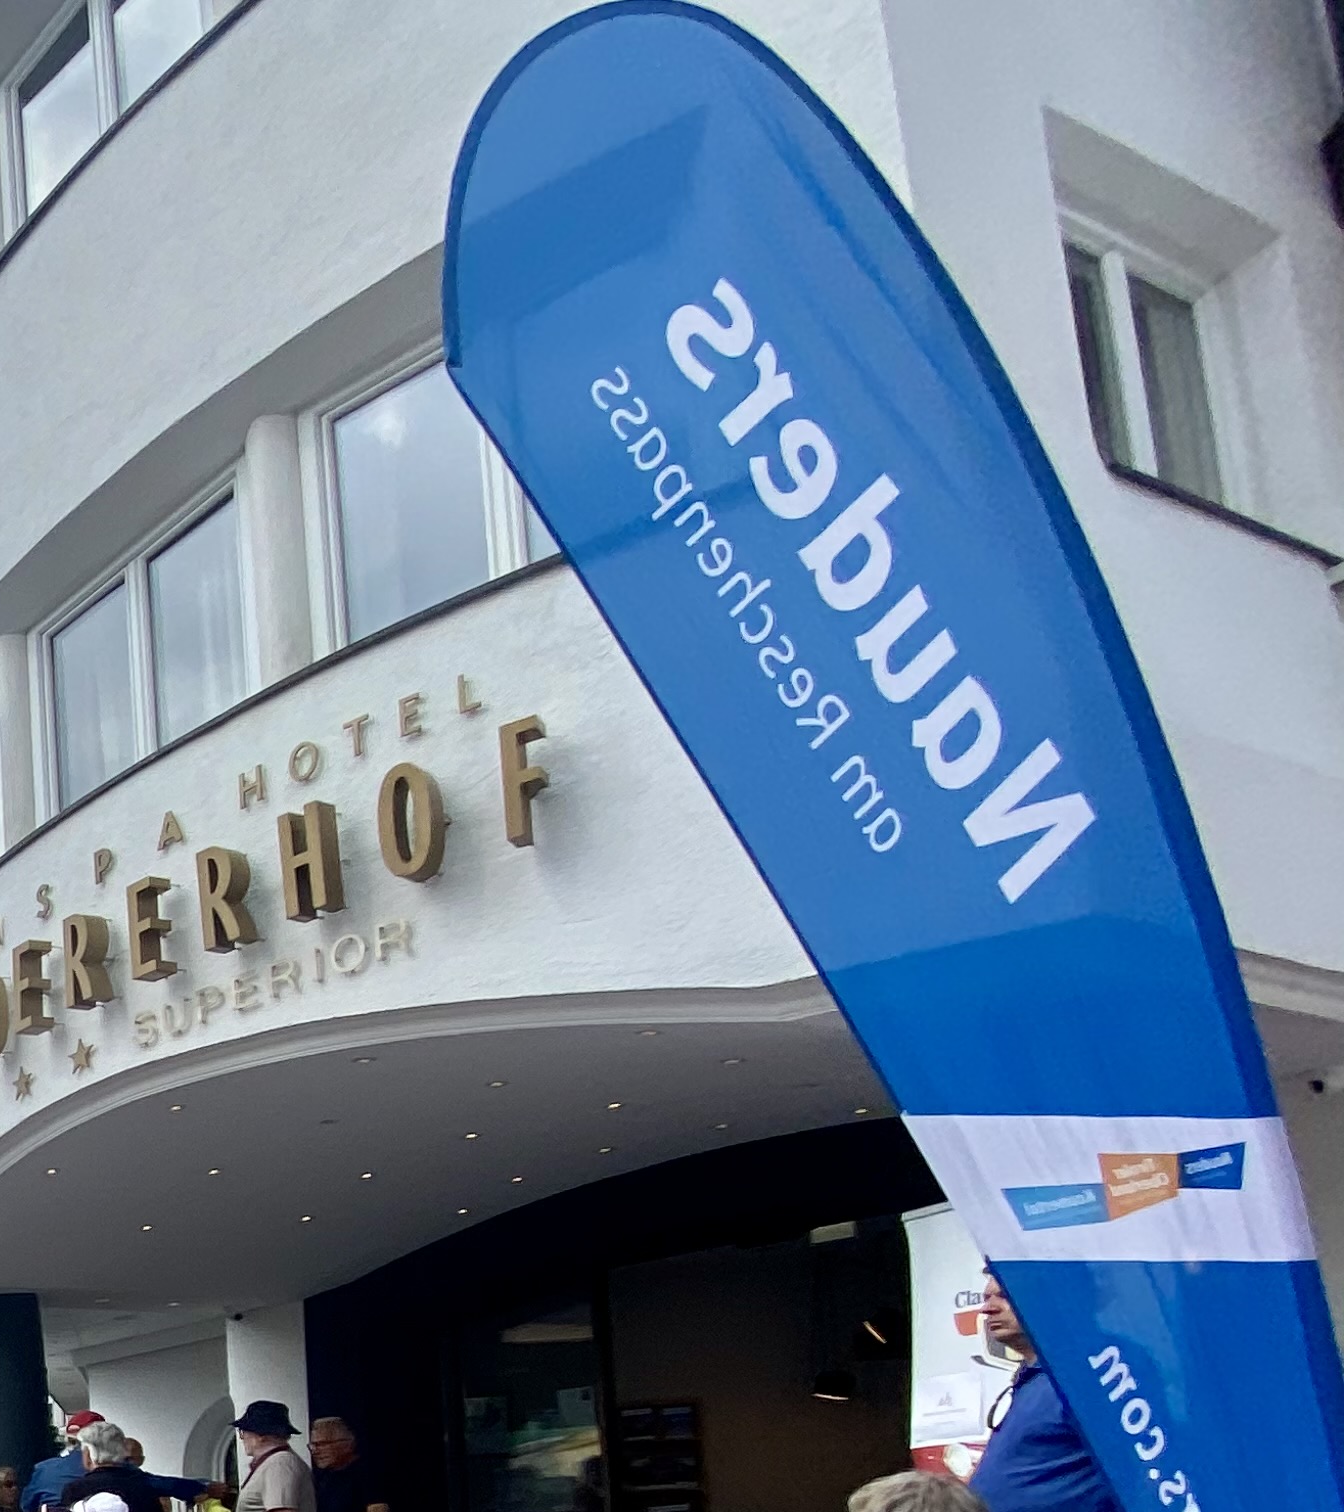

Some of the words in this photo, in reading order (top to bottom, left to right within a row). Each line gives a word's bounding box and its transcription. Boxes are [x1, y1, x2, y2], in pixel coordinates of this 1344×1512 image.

[35, 810, 185, 920] SPA
[238, 674, 485, 811] HOTEL
[132, 917, 414, 1049] SUPERIOR
